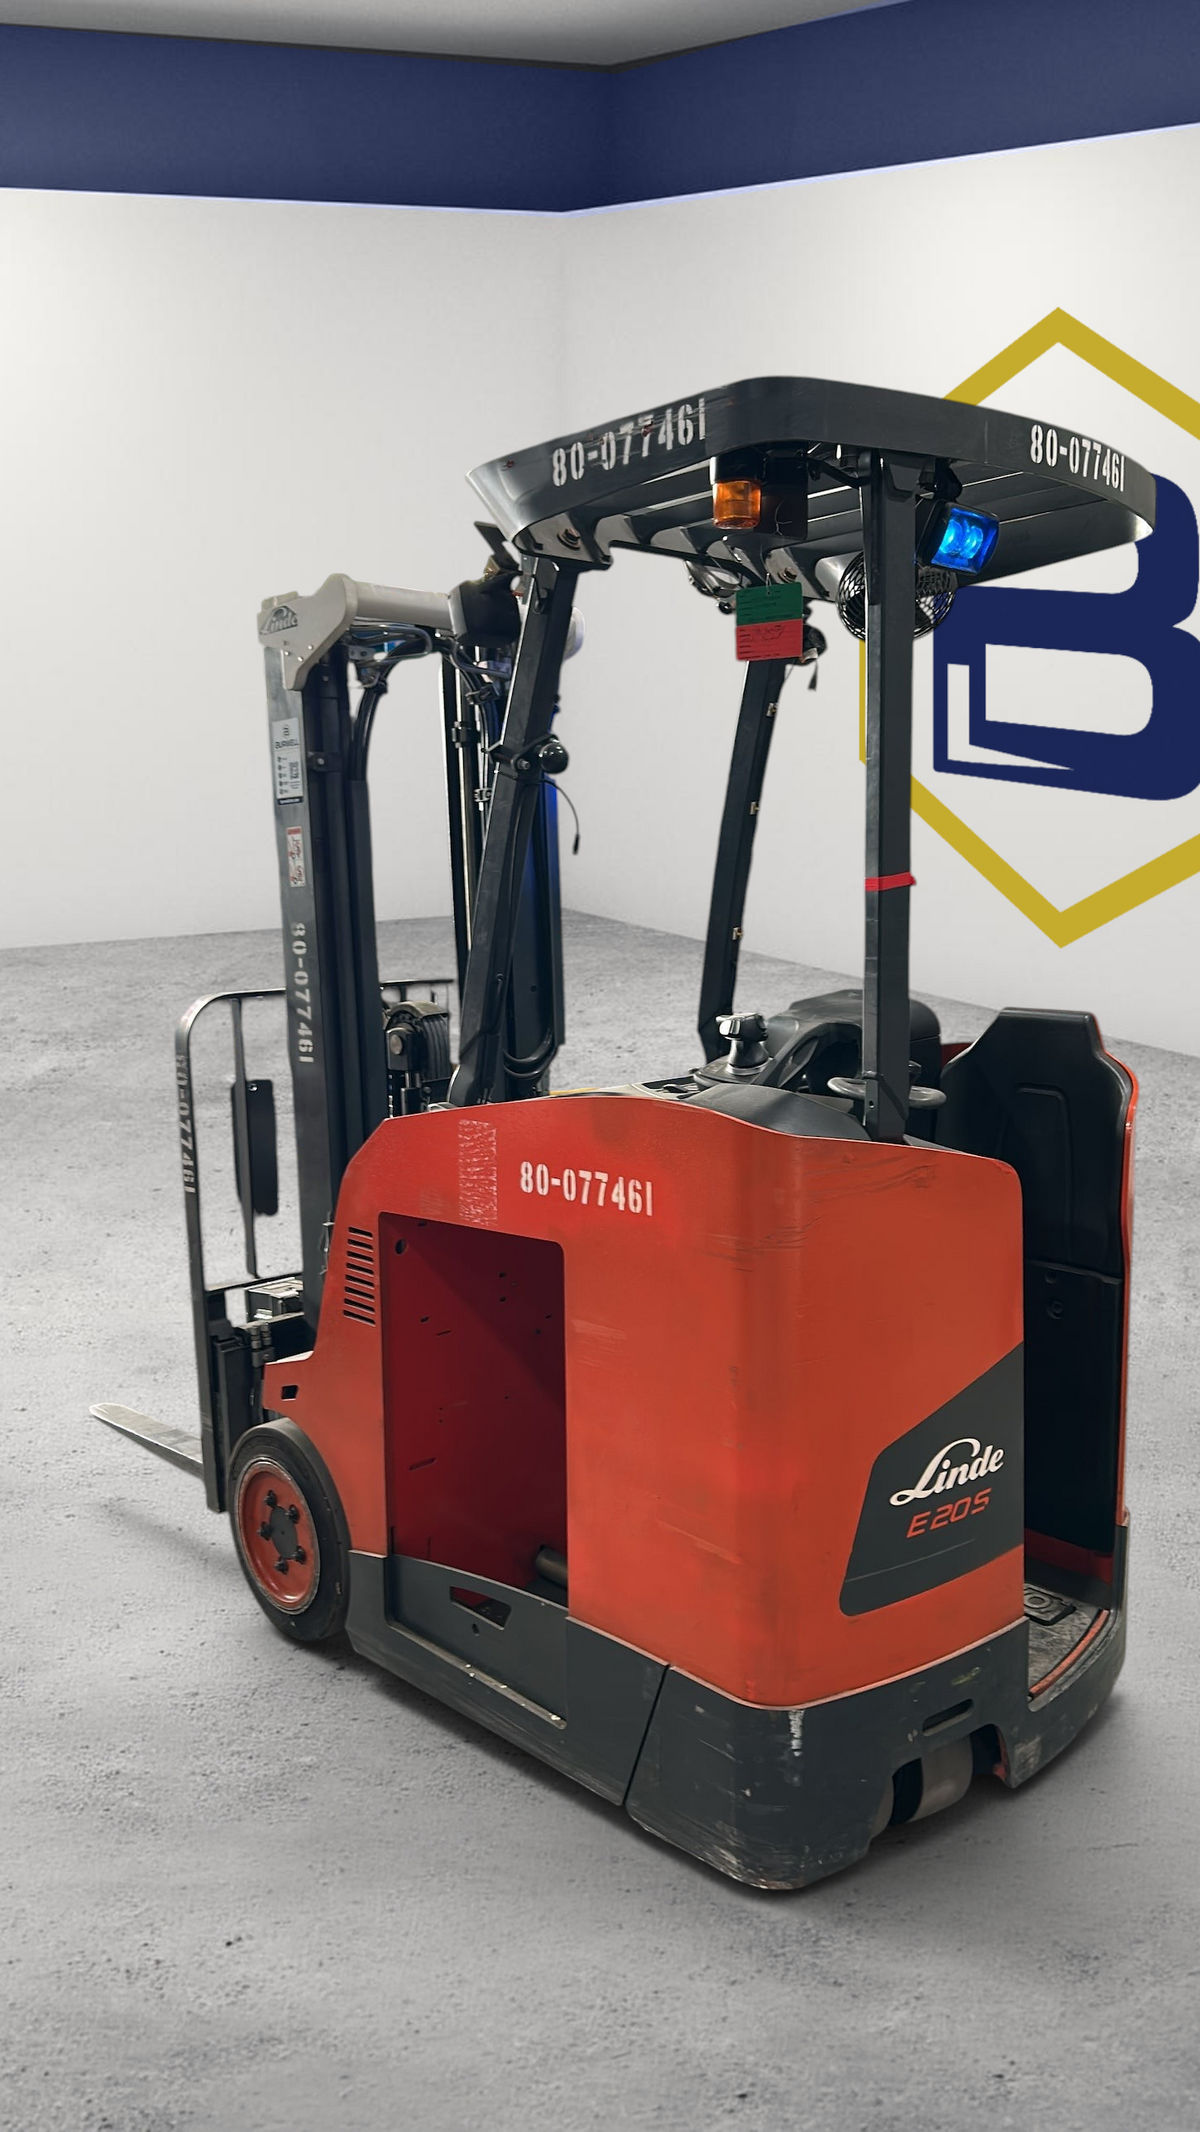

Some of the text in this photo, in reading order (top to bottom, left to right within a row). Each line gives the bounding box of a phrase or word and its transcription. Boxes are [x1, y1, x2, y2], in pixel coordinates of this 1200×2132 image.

[552, 398, 706, 487] 80-077461
[1030, 424, 1125, 492] 80-077461
[291, 922, 314, 1063] 80-077461
[520, 1161, 653, 1216] 80-077461
[889, 1437, 1004, 1506] Linde
